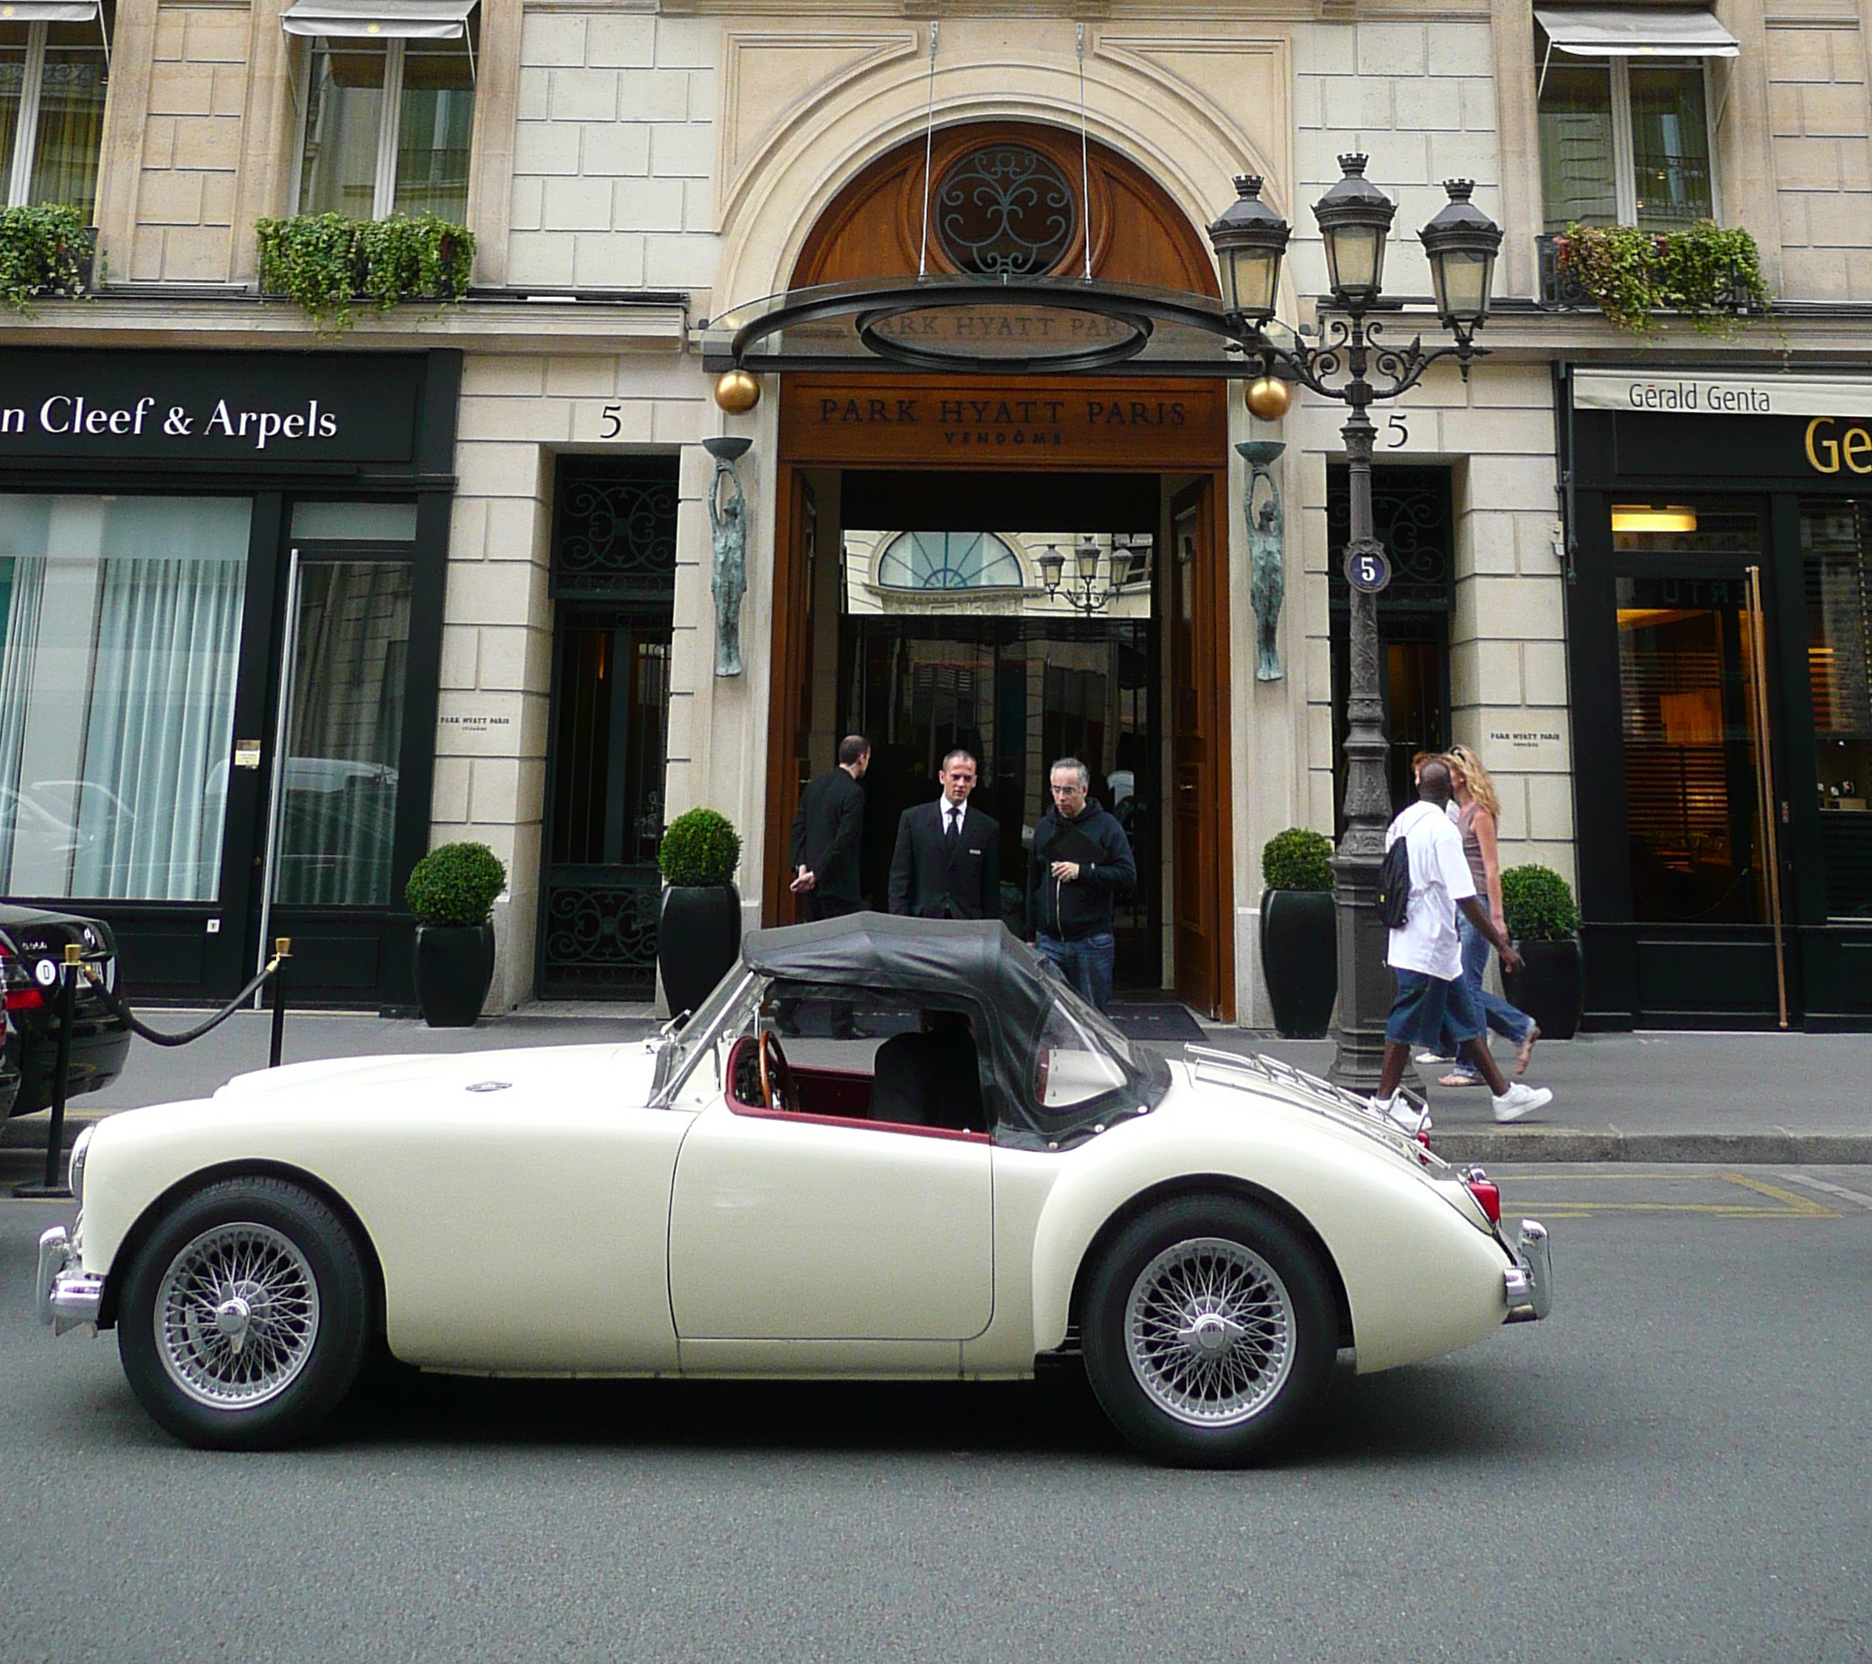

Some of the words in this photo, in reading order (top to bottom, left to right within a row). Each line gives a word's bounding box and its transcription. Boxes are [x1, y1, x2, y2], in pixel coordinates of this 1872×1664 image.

[880, 316, 938, 335] ARK
[955, 316, 1055, 336] HYATT
[820, 398, 919, 423] PARK
[939, 400, 1066, 425] HYATT
[1087, 402, 1186, 427] PARIS
[1707, 386, 1771, 412] Genta
[40, 395, 156, 435] Cleef
[163, 406, 195, 436] &
[203, 398, 338, 450] Arpels
[600, 405, 622, 439] 5
[1387, 414, 1409, 448] 5
[943, 428, 1062, 445] VENDÔME
[1360, 556, 1376, 581] 5
